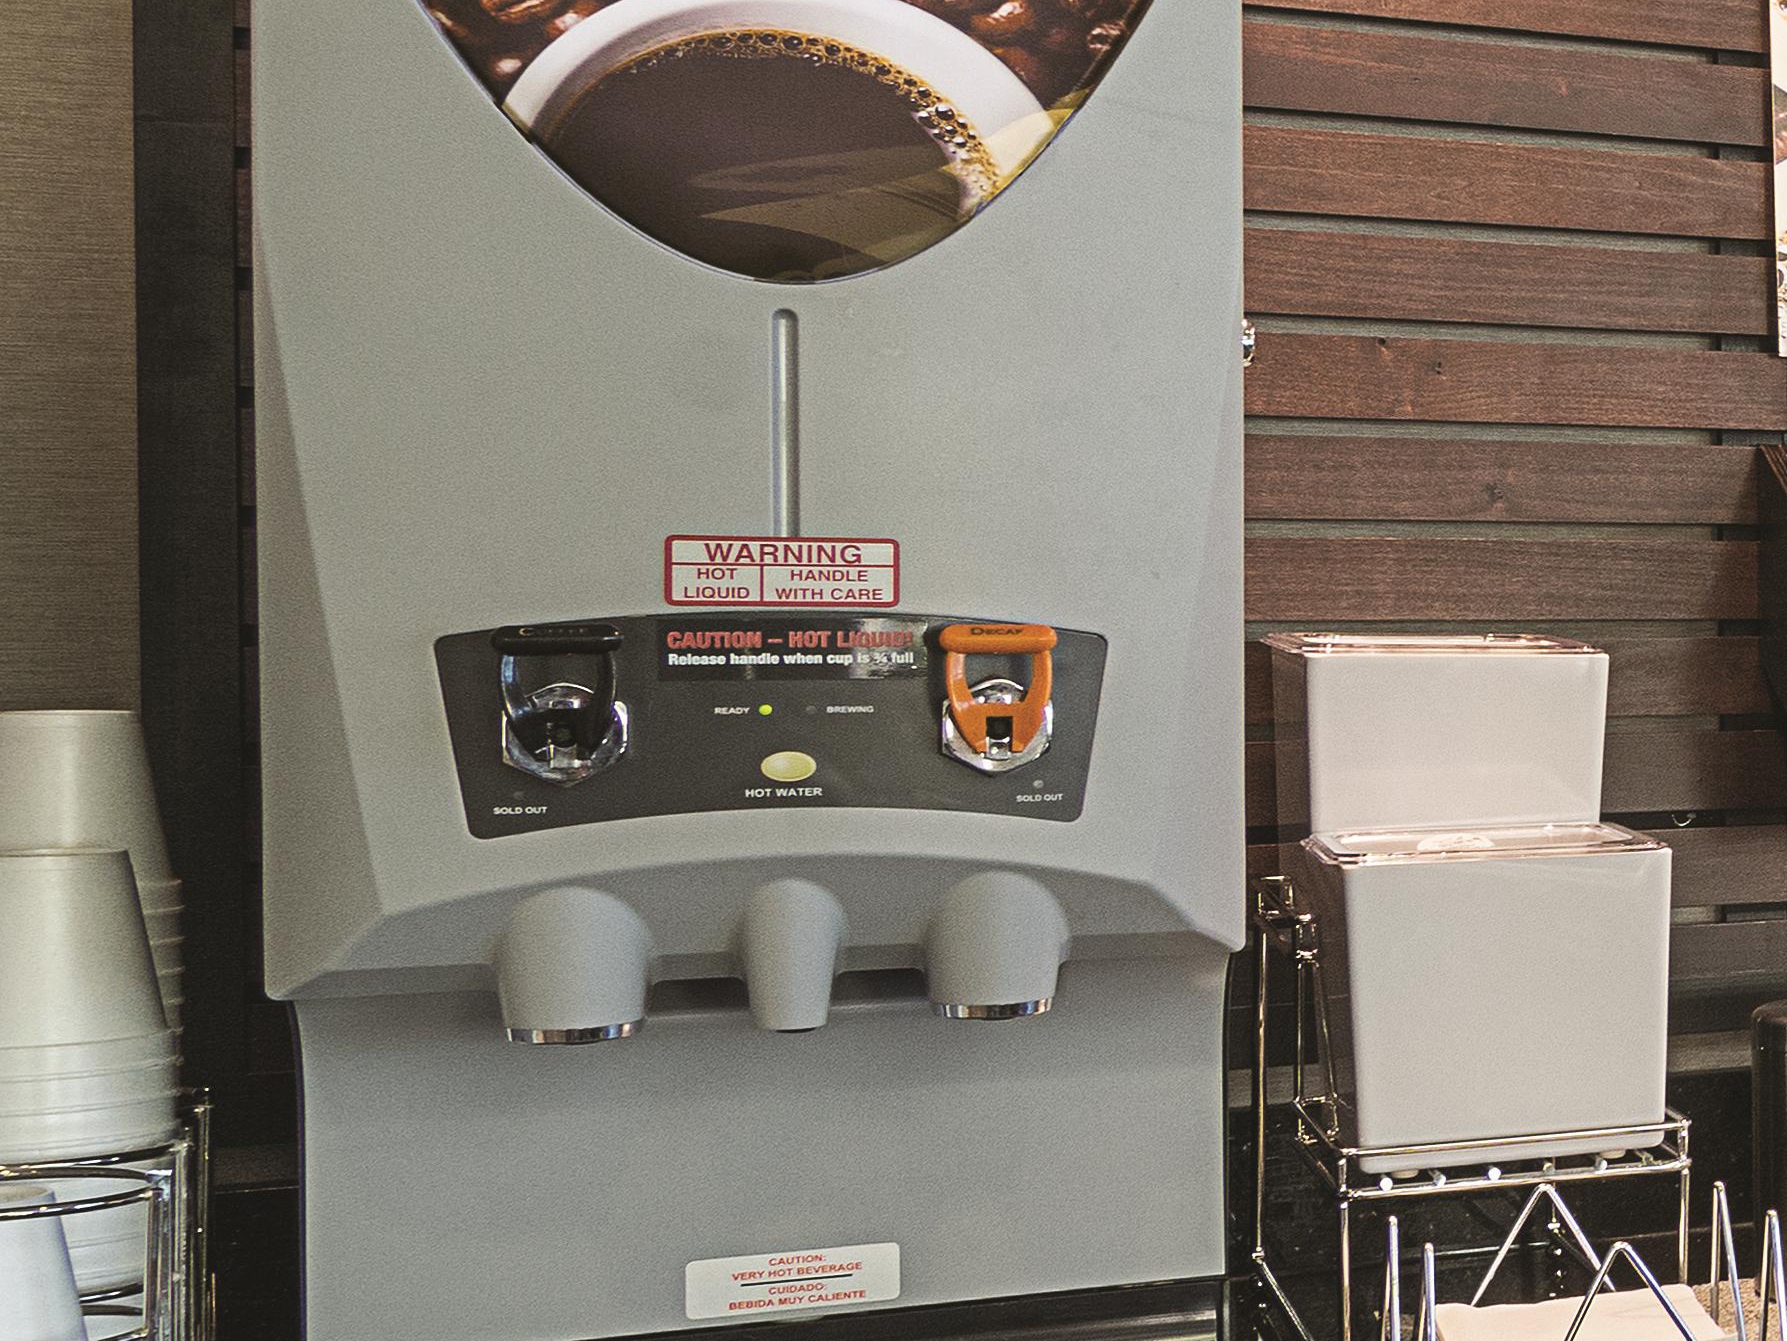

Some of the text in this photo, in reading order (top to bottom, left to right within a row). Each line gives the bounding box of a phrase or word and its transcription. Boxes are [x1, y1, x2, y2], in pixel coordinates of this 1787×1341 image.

[704, 542, 863, 565] WARNING
[696, 567, 738, 580] HOT
[789, 569, 869, 583] HANDLE
[684, 586, 751, 600] LIQUID
[775, 587, 884, 601] WITH CARE
[667, 630, 763, 649] CAUTION
[788, 630, 831, 649] HOT
[668, 653, 726, 666] Release
[730, 652, 780, 665] handle
[783, 653, 823, 665] when
[826, 655, 853, 667] cup
[857, 652, 870, 664] is
[890, 651, 914, 664] full
[714, 705, 875, 715] READY BREWING
[744, 787, 823, 798] HOT WATER
[1016, 793, 1064, 803] SOLD OUT
[493, 805, 548, 815] SOLD OUT
[767, 1254, 826, 1267] CAUTION:
[731, 1262, 864, 1282] VERY HOT BEVERAGE
[767, 1283, 828, 1296] CUIDADO:
[728, 1290, 867, 1311] BEBIDA MUY CALIENTE
